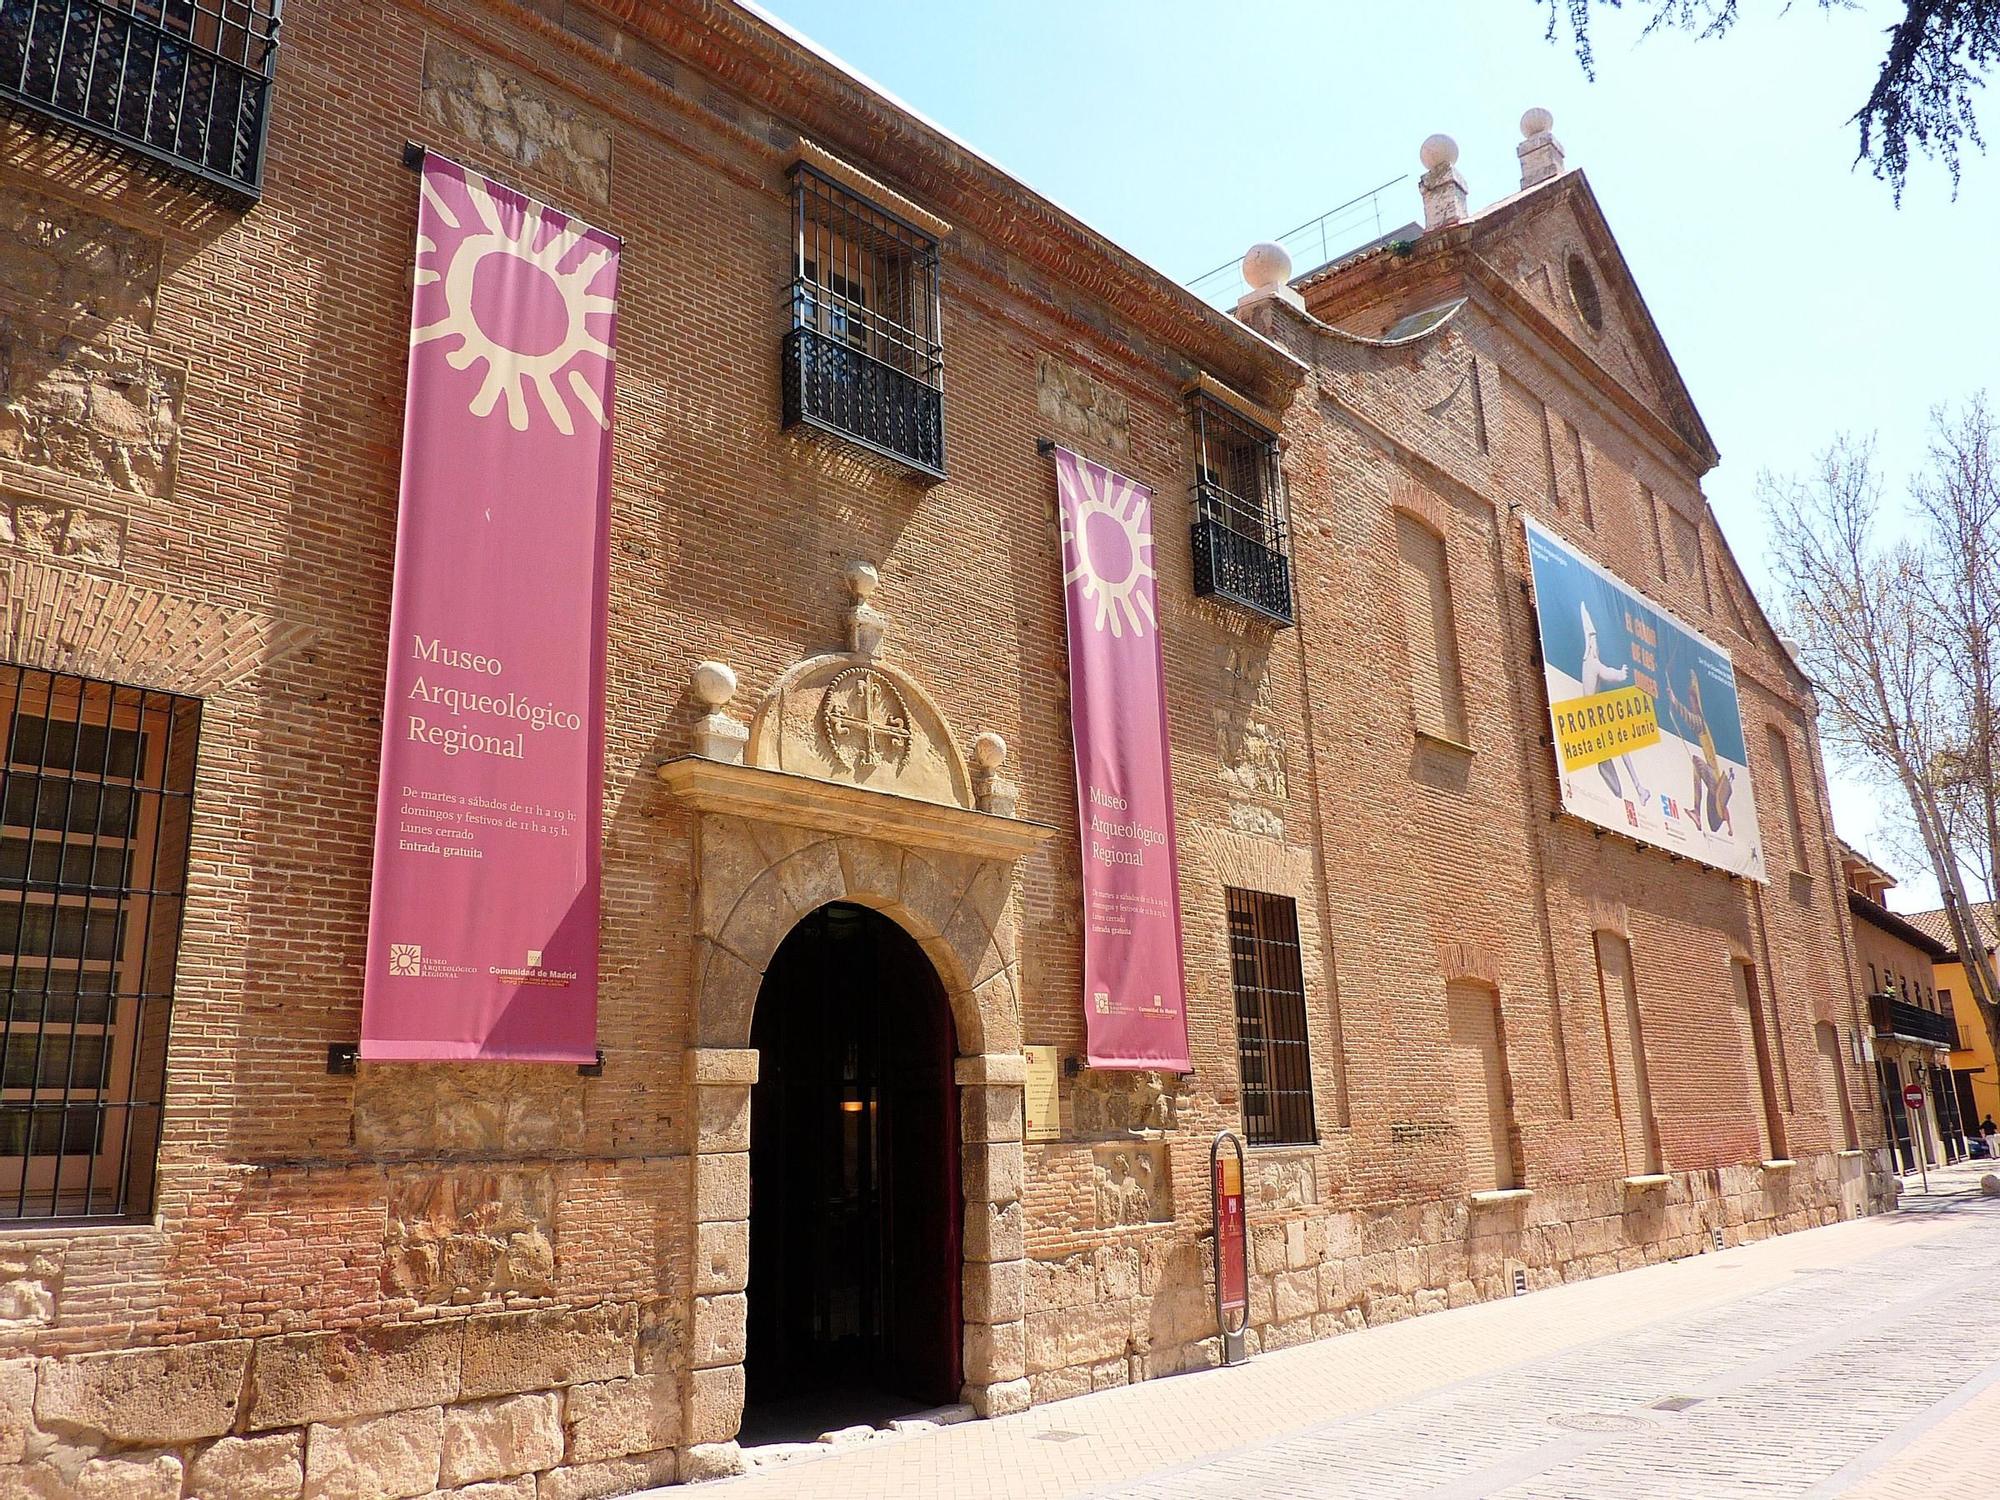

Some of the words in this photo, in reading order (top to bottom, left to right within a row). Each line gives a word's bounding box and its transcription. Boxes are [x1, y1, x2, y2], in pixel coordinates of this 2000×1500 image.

[412, 634, 502, 676] Museo
[408, 676, 581, 731] Arqueológico
[1558, 695, 1650, 736] PRORROGADA
[407, 716, 524, 759] Regional
[1564, 738, 1594, 760] Hasta
[1596, 732, 1606, 750] el
[1608, 730, 1614, 746] 9
[1617, 727, 1628, 743] de
[1632, 720, 1655, 738] Junio
[402, 786, 418, 798] De
[420, 791, 457, 804] martes
[459, 796, 465, 804] a
[468, 796, 508, 810] sábados
[510, 801, 522, 813] de
[525, 806, 533, 814] 11
[536, 805, 543, 816] h
[545, 809, 551, 817] a
[554, 810, 564, 822] 19
[568, 809, 577, 822] h;
[1089, 786, 1128, 811] Museo
[400, 804, 454, 821] domingos
[456, 813, 462, 823] y
[465, 812, 503, 827] festivos
[505, 818, 517, 828] de
[520, 822, 529, 830] 11
[532, 821, 539, 832] h
[541, 825, 547, 833] a
[550, 826, 559, 837] 15
[400, 822, 432, 835] Lunes
[436, 827, 474, 840] cerrado
[1091, 814, 1165, 846] Arqueológico
[400, 840, 440, 854] Entrada
[443, 846, 483, 859] gratuita
[1092, 841, 1144, 867] Regional
[489, 966, 535, 976] Comunidad
[550, 970, 577, 979] Madrid
